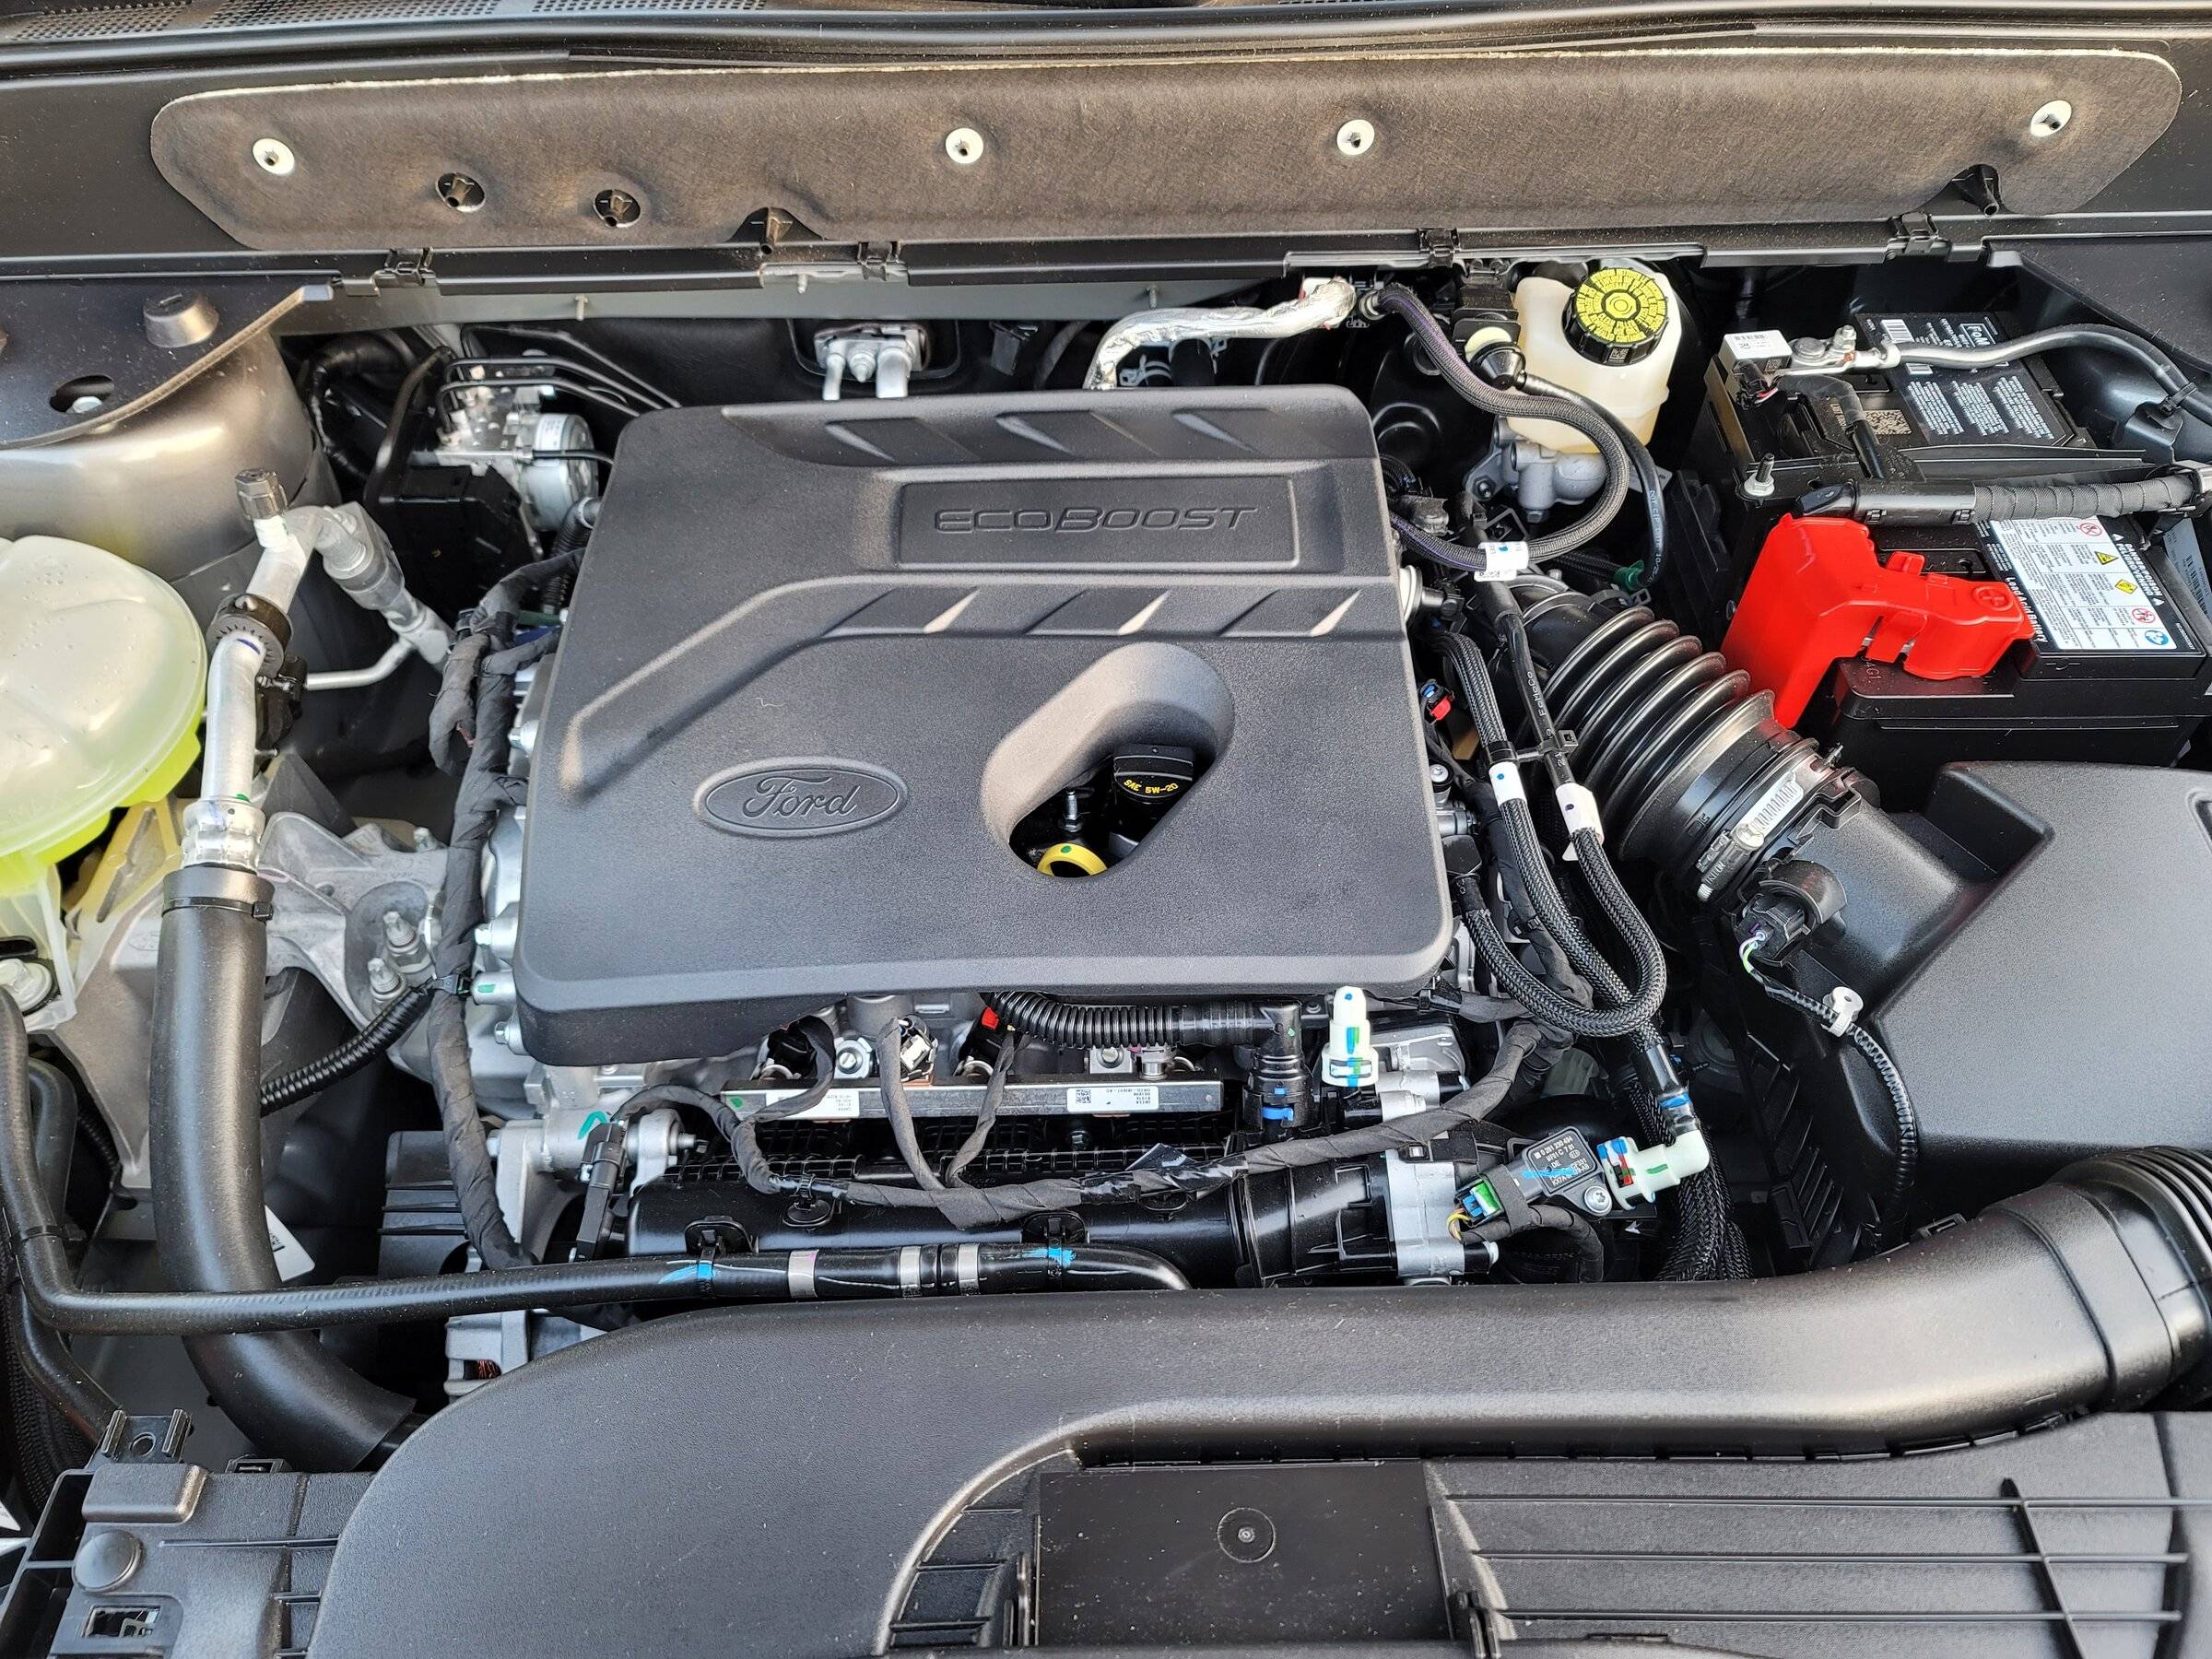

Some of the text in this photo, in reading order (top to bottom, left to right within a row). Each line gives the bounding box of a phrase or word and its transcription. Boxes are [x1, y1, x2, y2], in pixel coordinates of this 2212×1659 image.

[2006, 576, 2025, 596] Lead
[2017, 595, 2034, 614] Acid
[2028, 614, 2049, 642] Battery
[1527, 671, 1547, 716] FoMoCo
[743, 776, 861, 818] Ford
[1124, 779, 1179, 794] SAE 5W-20
